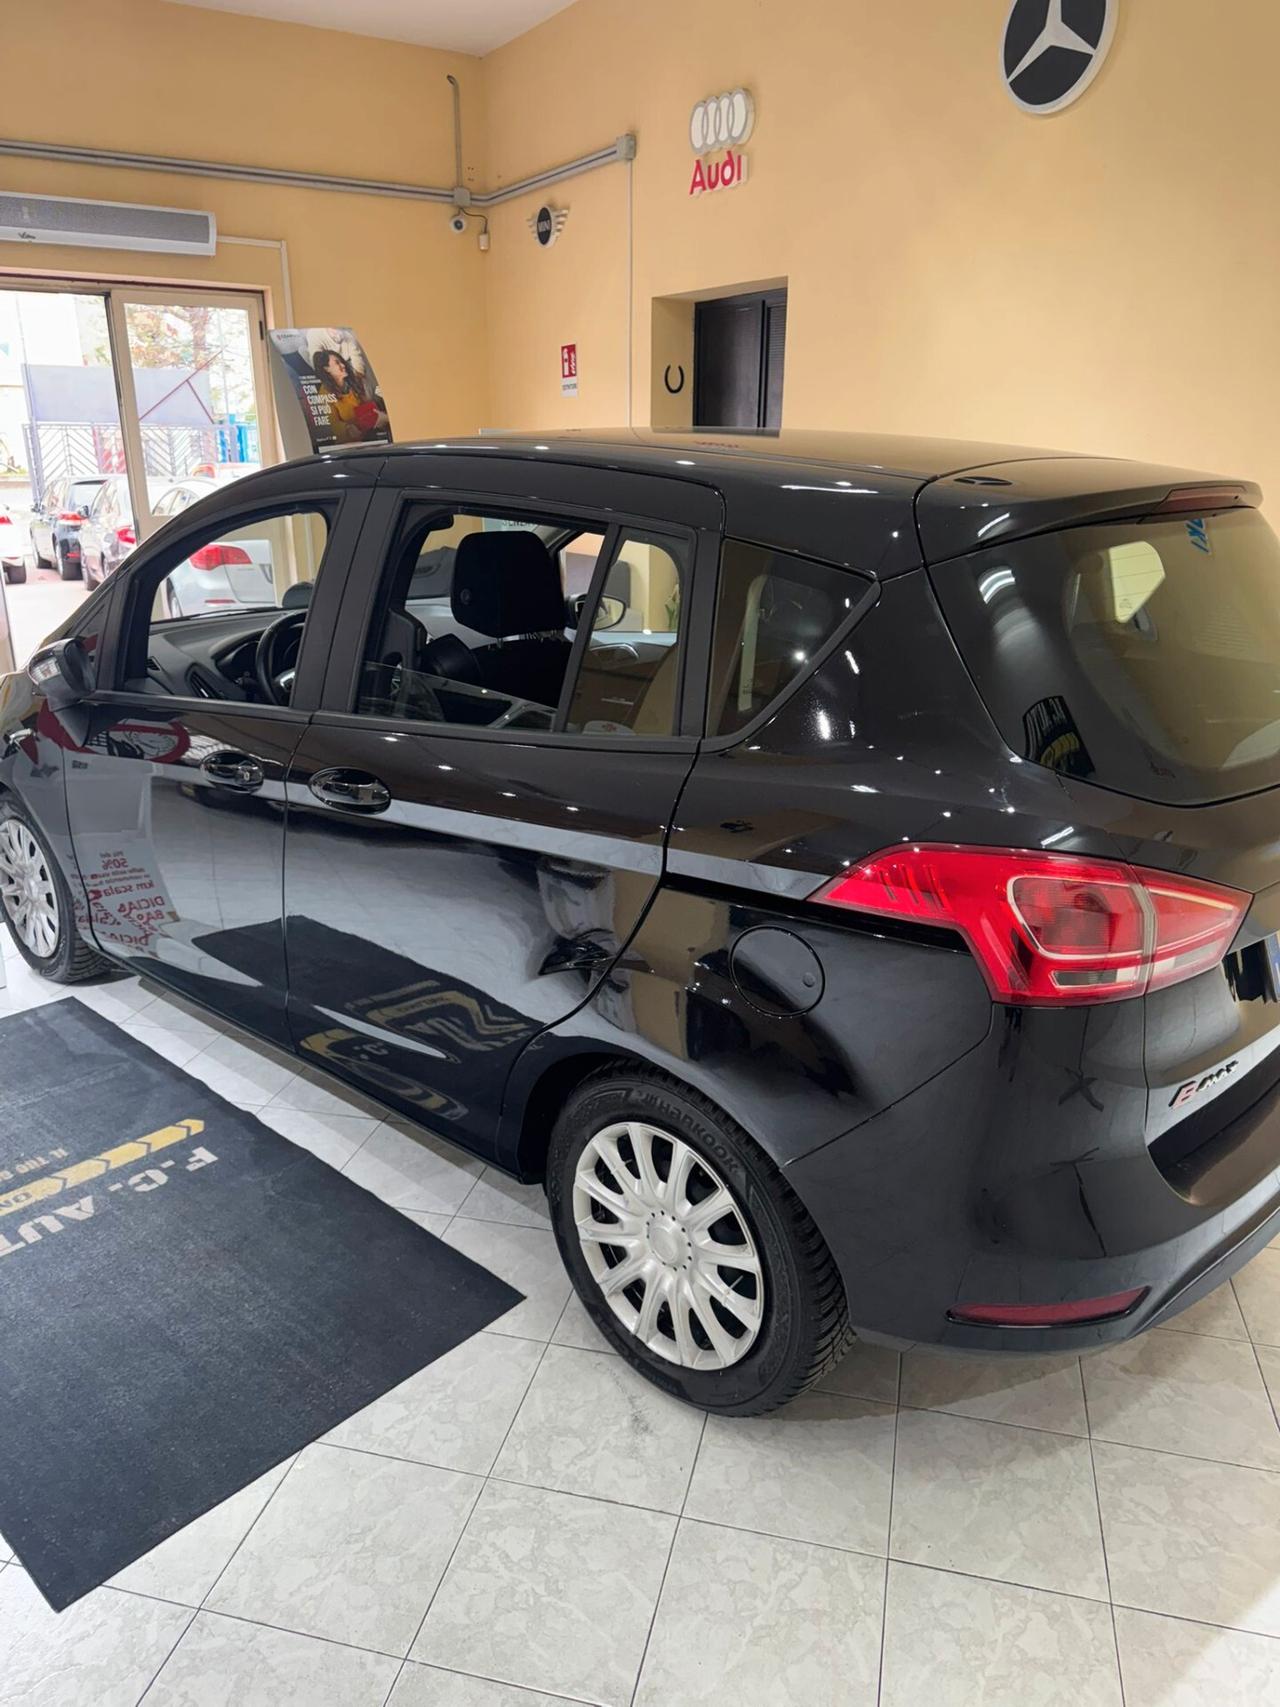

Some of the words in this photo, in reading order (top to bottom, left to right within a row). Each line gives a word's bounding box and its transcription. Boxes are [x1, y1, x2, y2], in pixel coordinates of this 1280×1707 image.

[690, 150, 742, 195] Audi
[303, 384, 318, 395] CON
[307, 393, 338, 405] COMPASS
[311, 405, 319, 415] SI
[314, 415, 331, 426] FARE
